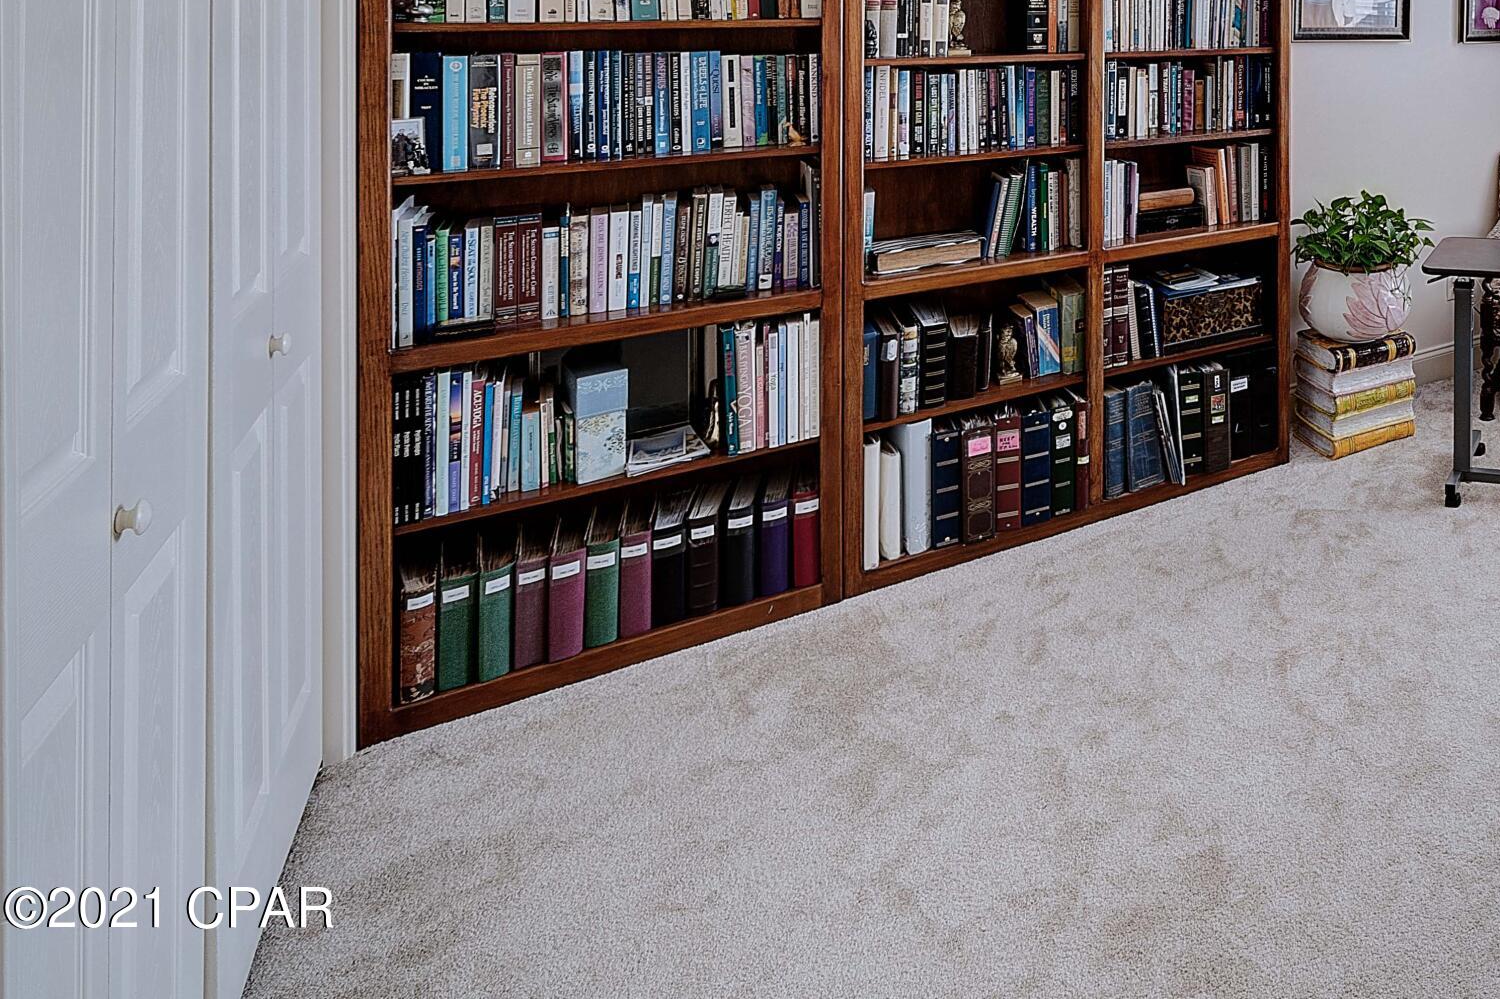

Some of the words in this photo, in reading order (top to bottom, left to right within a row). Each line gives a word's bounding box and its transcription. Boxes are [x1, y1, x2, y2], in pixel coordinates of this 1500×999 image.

[658, 56, 666, 89] JOSEPHUS
[698, 56, 707, 84] WHEELS
[711, 68, 721, 94] Quest
[481, 88, 489, 99] The
[879, 69, 887, 101] INFIDEL
[471, 102, 480, 128] Mystery
[480, 100, 489, 128] Phoenix
[699, 93, 707, 108] LIFE
[724, 199, 735, 231] PERFECT
[722, 233, 733, 263] HEALTH
[473, 390, 482, 428] ACU-YOGA
[738, 386, 752, 428] YOGA
